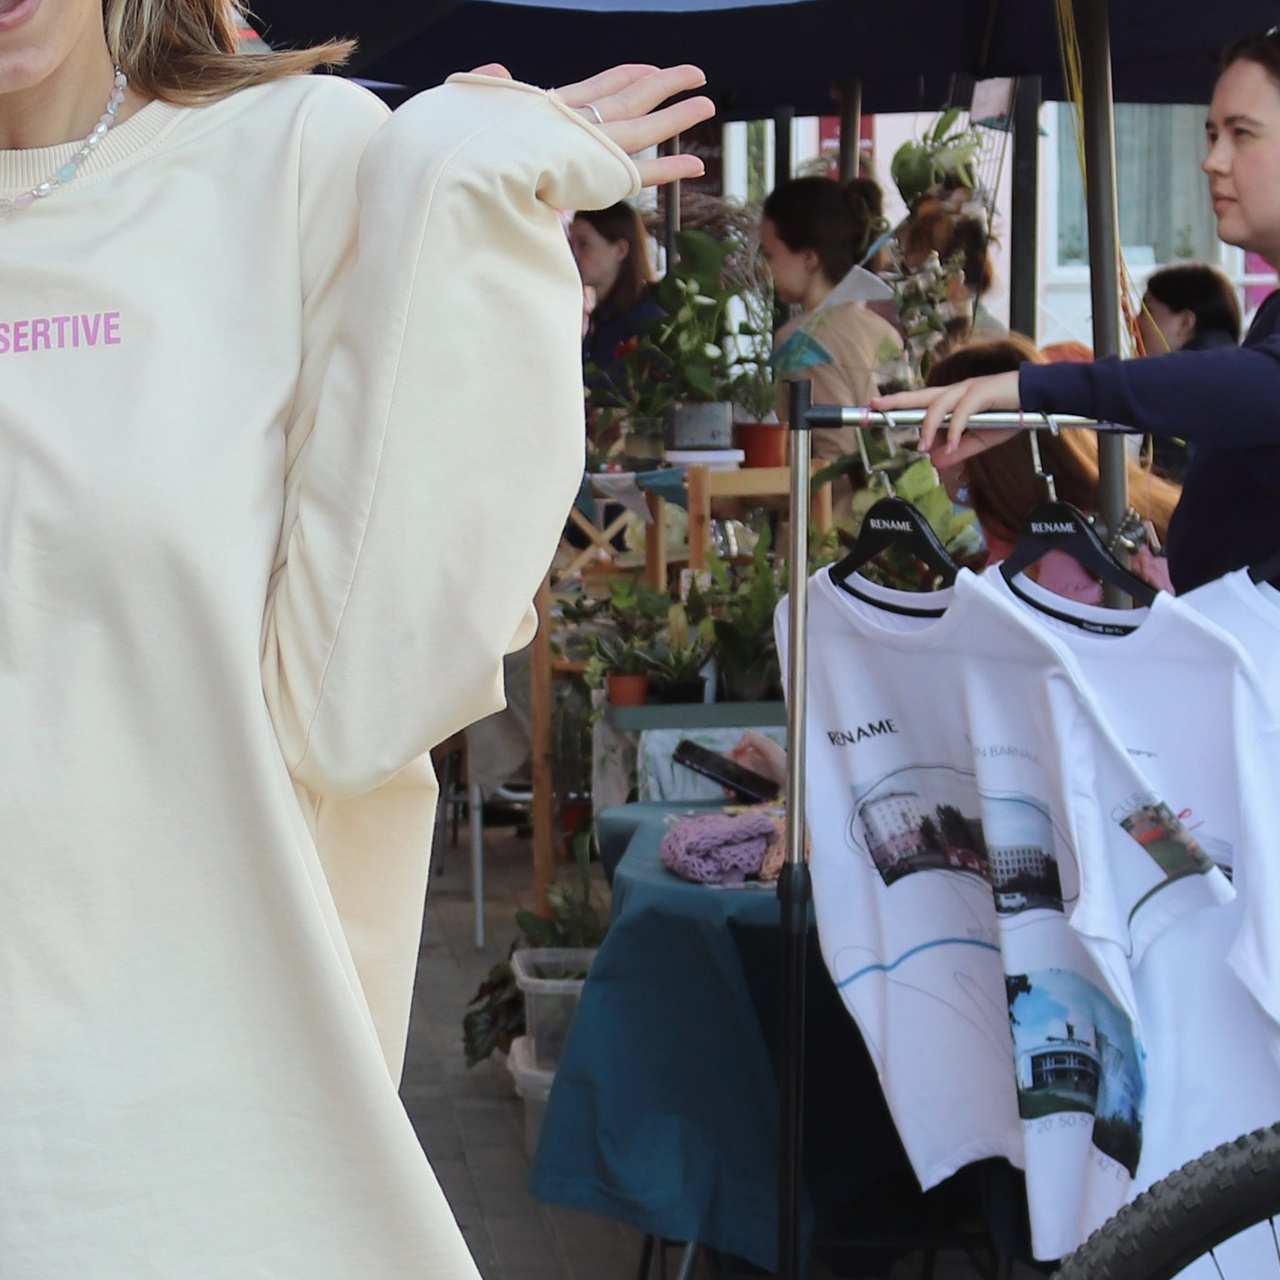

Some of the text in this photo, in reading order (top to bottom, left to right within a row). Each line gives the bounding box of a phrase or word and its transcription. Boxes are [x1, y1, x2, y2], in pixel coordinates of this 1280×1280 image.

[869, 518, 913, 532] RENAME
[1031, 522, 1077, 533] RENAME
[827, 718, 898, 748] RENAME
